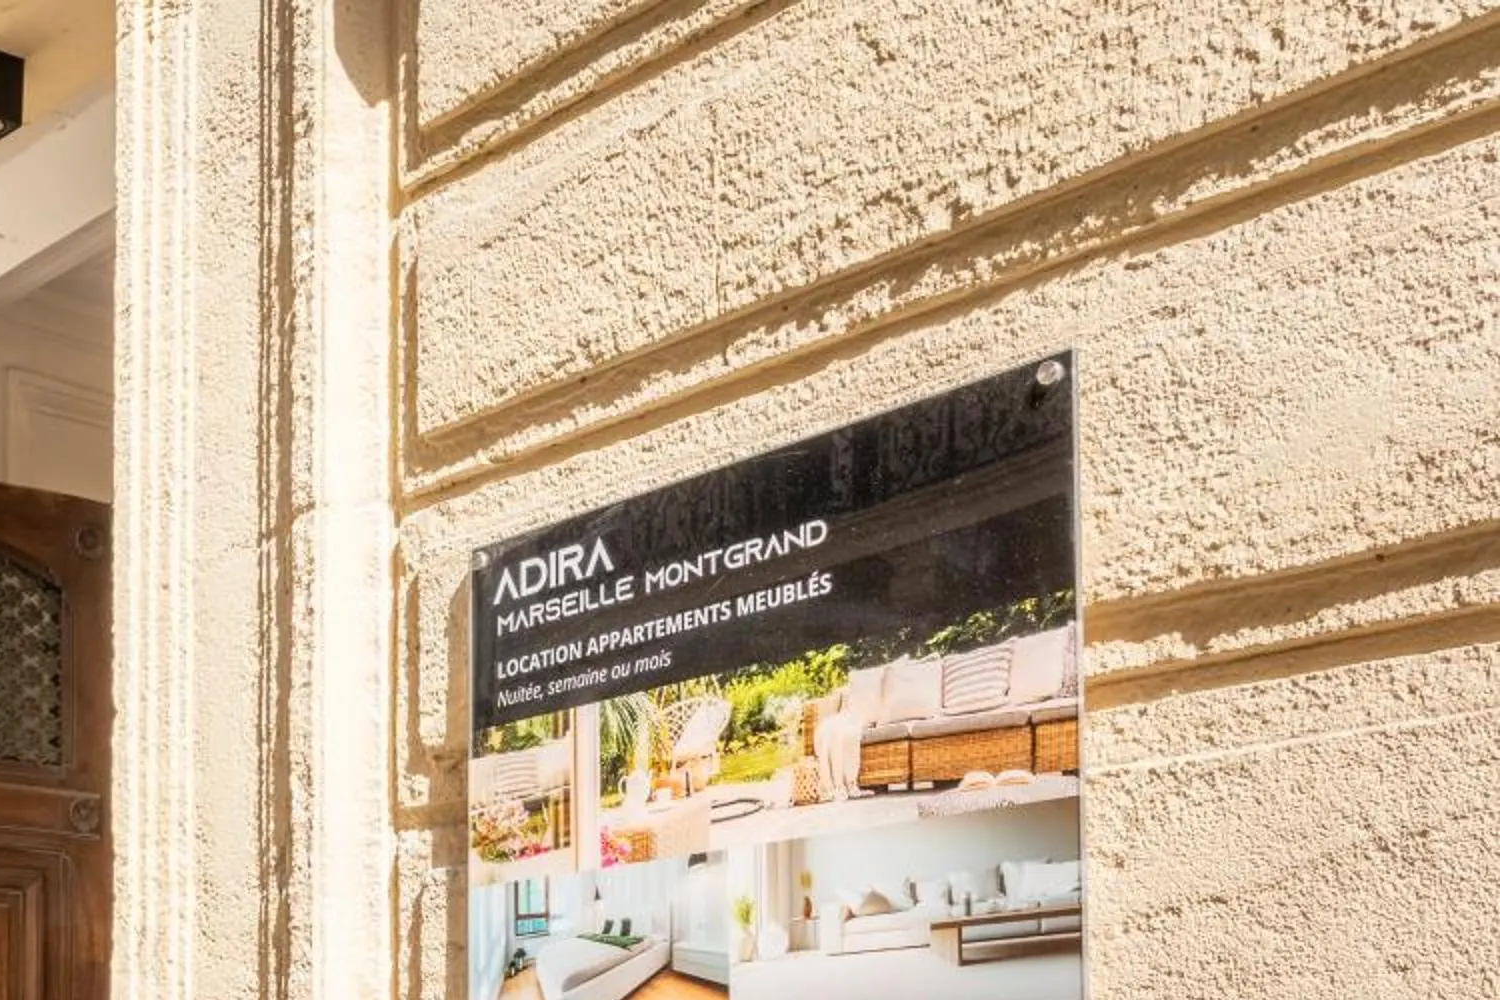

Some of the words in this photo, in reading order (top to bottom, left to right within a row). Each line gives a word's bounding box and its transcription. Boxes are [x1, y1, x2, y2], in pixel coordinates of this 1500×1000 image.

[493, 536, 614, 604] ADIRA
[497, 576, 635, 637] MARSEILLE
[645, 519, 828, 595] MONTGRAND
[497, 640, 582, 680] LOCATION
[586, 599, 732, 656] APPARTEMENTS
[737, 571, 833, 618] MEUBLÉS
[497, 681, 544, 708] Nuitée,
[547, 667, 607, 695] semaine
[611, 661, 631, 678] ou
[634, 649, 672, 674] mois
